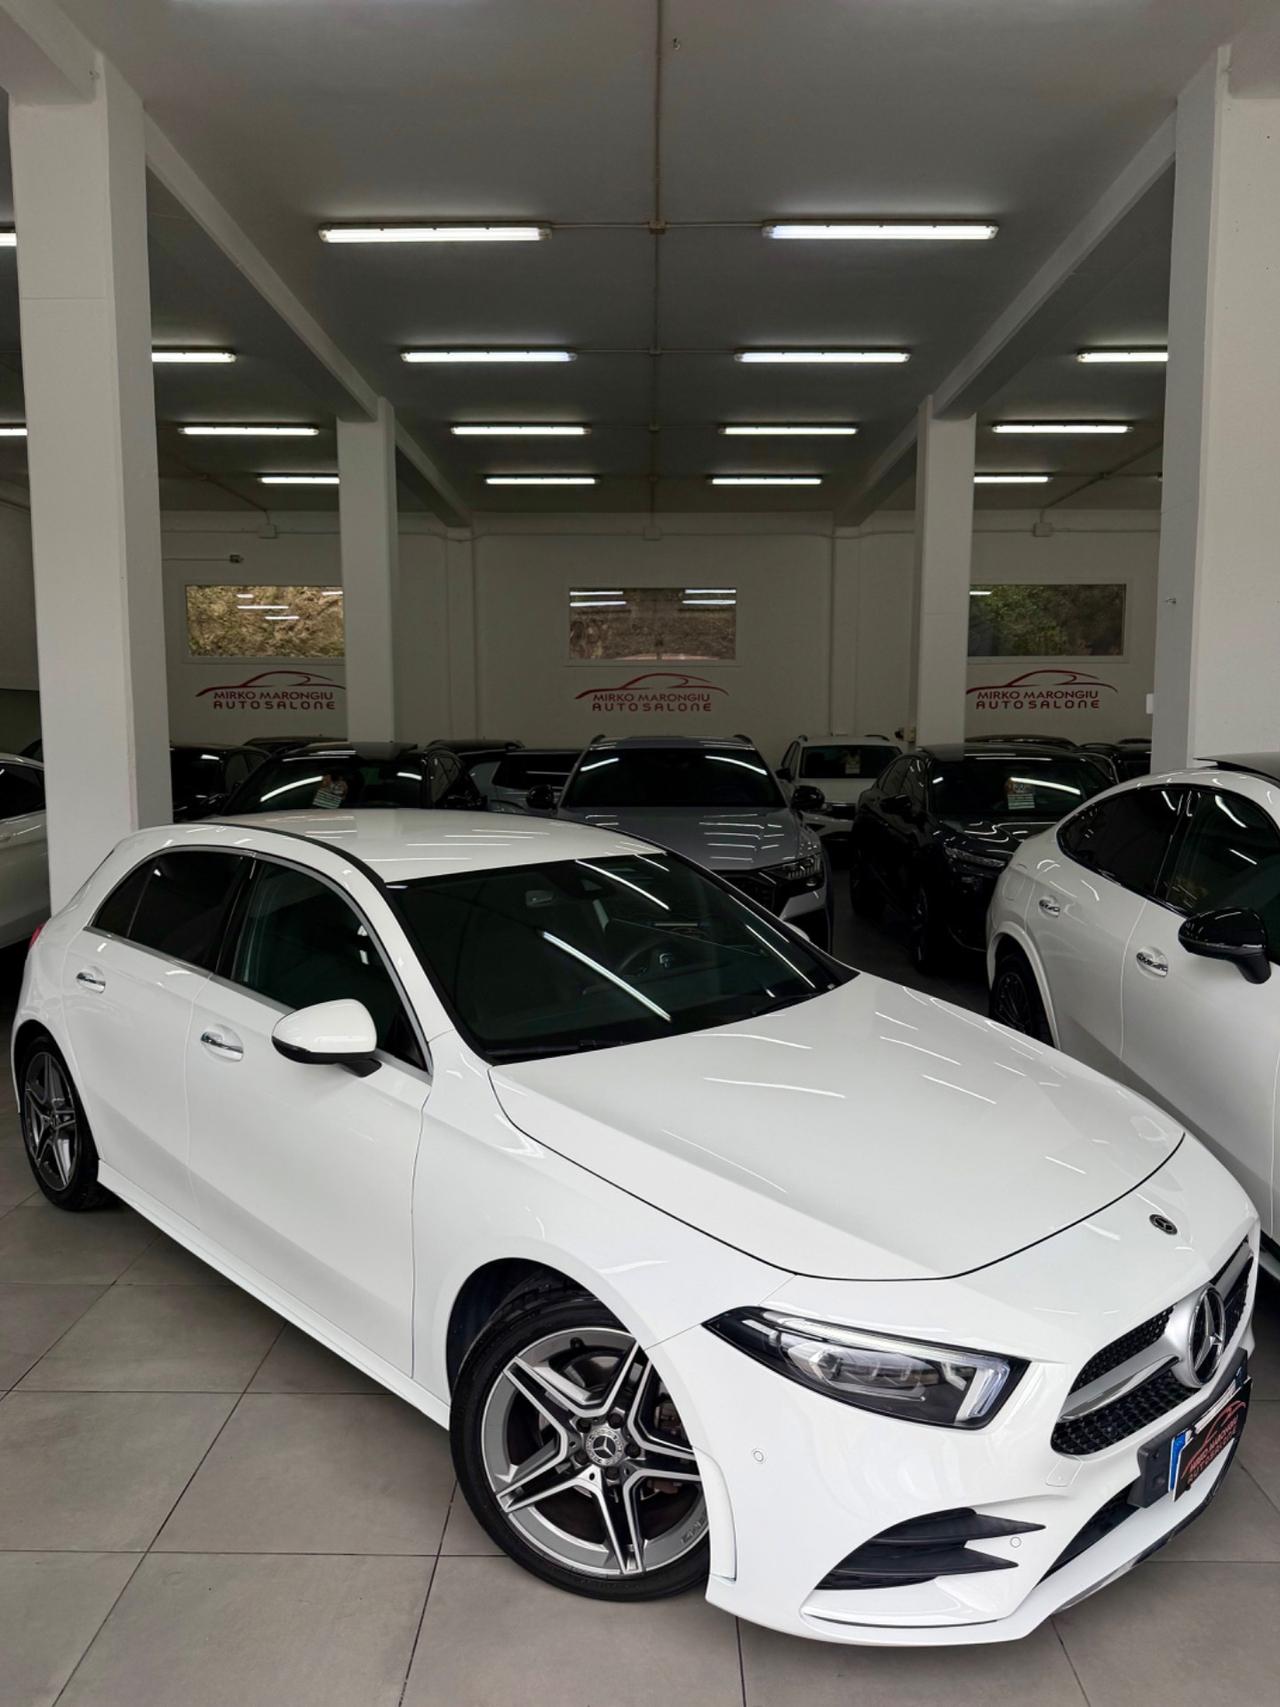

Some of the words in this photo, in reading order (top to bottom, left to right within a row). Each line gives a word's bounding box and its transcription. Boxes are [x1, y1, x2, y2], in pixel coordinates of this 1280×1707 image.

[213, 691, 257, 700] MIRKO
[259, 691, 334, 700] MARONGIU
[593, 693, 634, 702] MIRKO
[638, 693, 711, 702] MARONGIU
[976, 690, 1020, 700] MIRKO
[1023, 690, 1099, 700] MARONGIU
[213, 700, 336, 711] AUTOSALONE
[592, 702, 712, 712] AUTOSALONE
[975, 699, 1101, 710] AUTOSALONE
